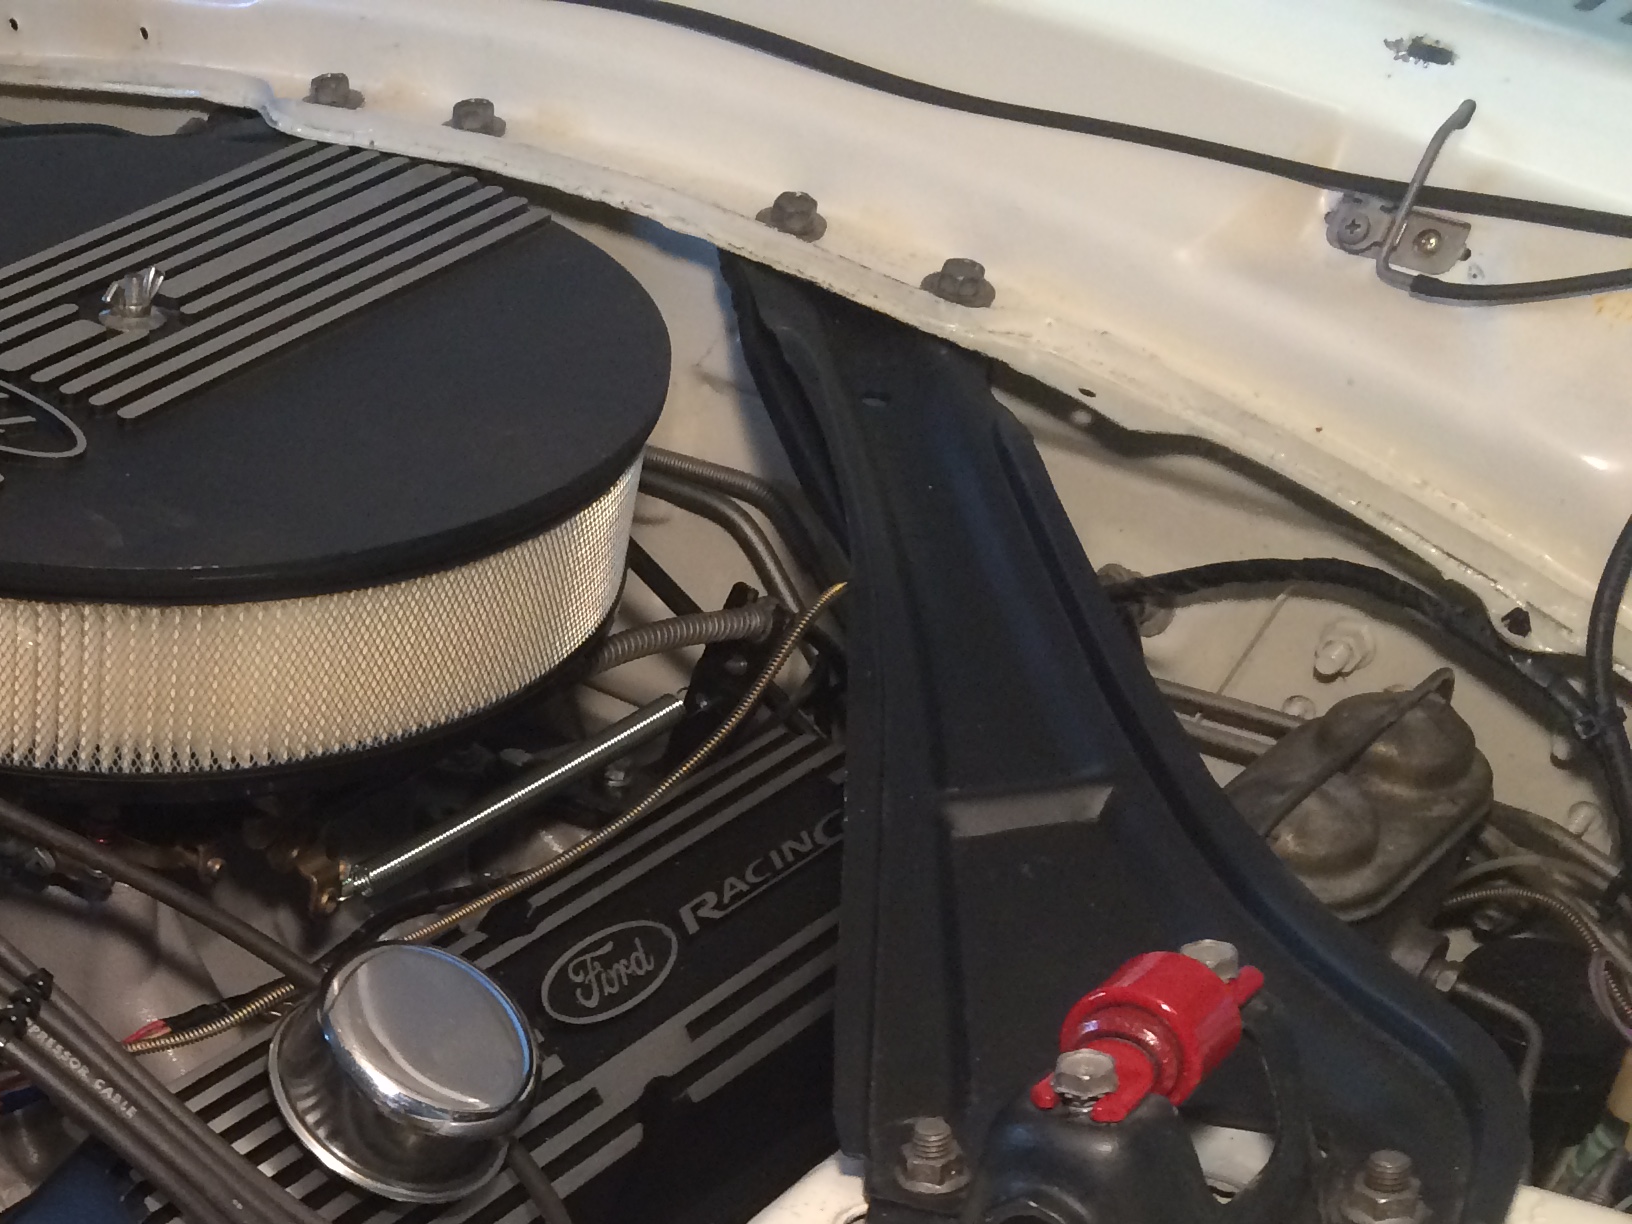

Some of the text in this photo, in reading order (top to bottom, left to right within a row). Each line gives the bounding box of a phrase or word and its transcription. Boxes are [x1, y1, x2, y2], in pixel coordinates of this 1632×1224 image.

[568, 937, 655, 1008] Ford
[26, 1017, 90, 1079] PRESSOR
[93, 1079, 138, 1120] CABLE
